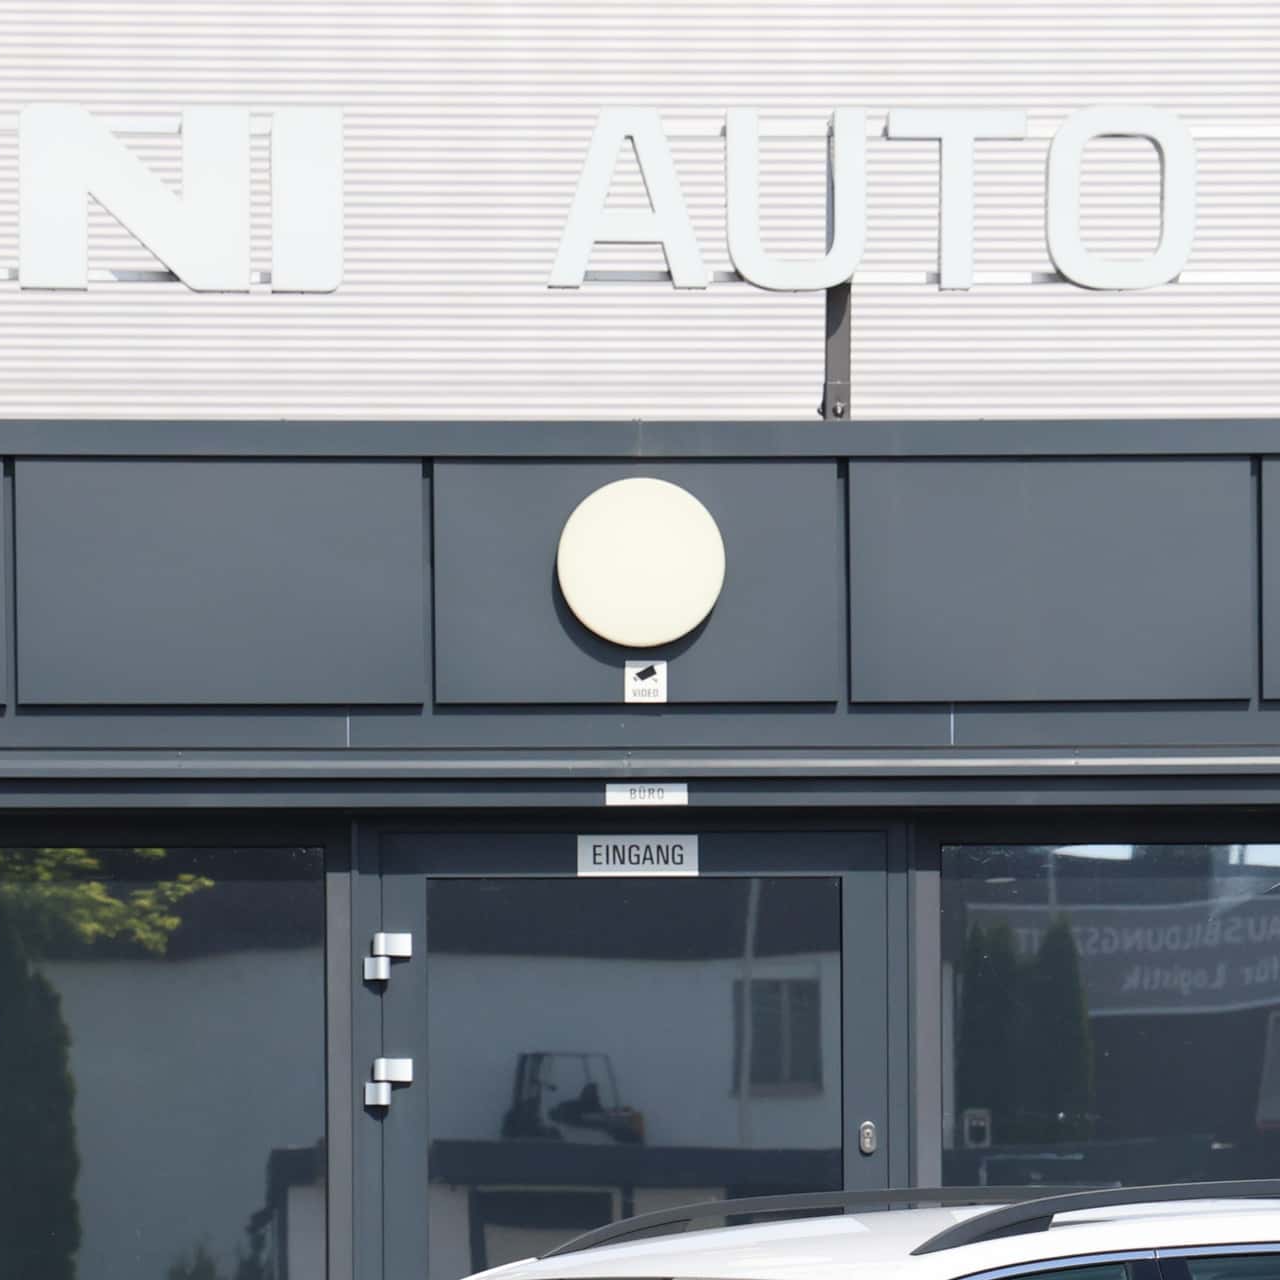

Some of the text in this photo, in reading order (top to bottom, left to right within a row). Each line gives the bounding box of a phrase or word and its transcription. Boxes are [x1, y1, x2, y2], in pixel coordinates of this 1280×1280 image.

[547, 108, 1194, 292] AUTO
[632, 688, 659, 698] VIDEO
[629, 786, 665, 800] BÜRO
[592, 844, 684, 866] EINGANG
